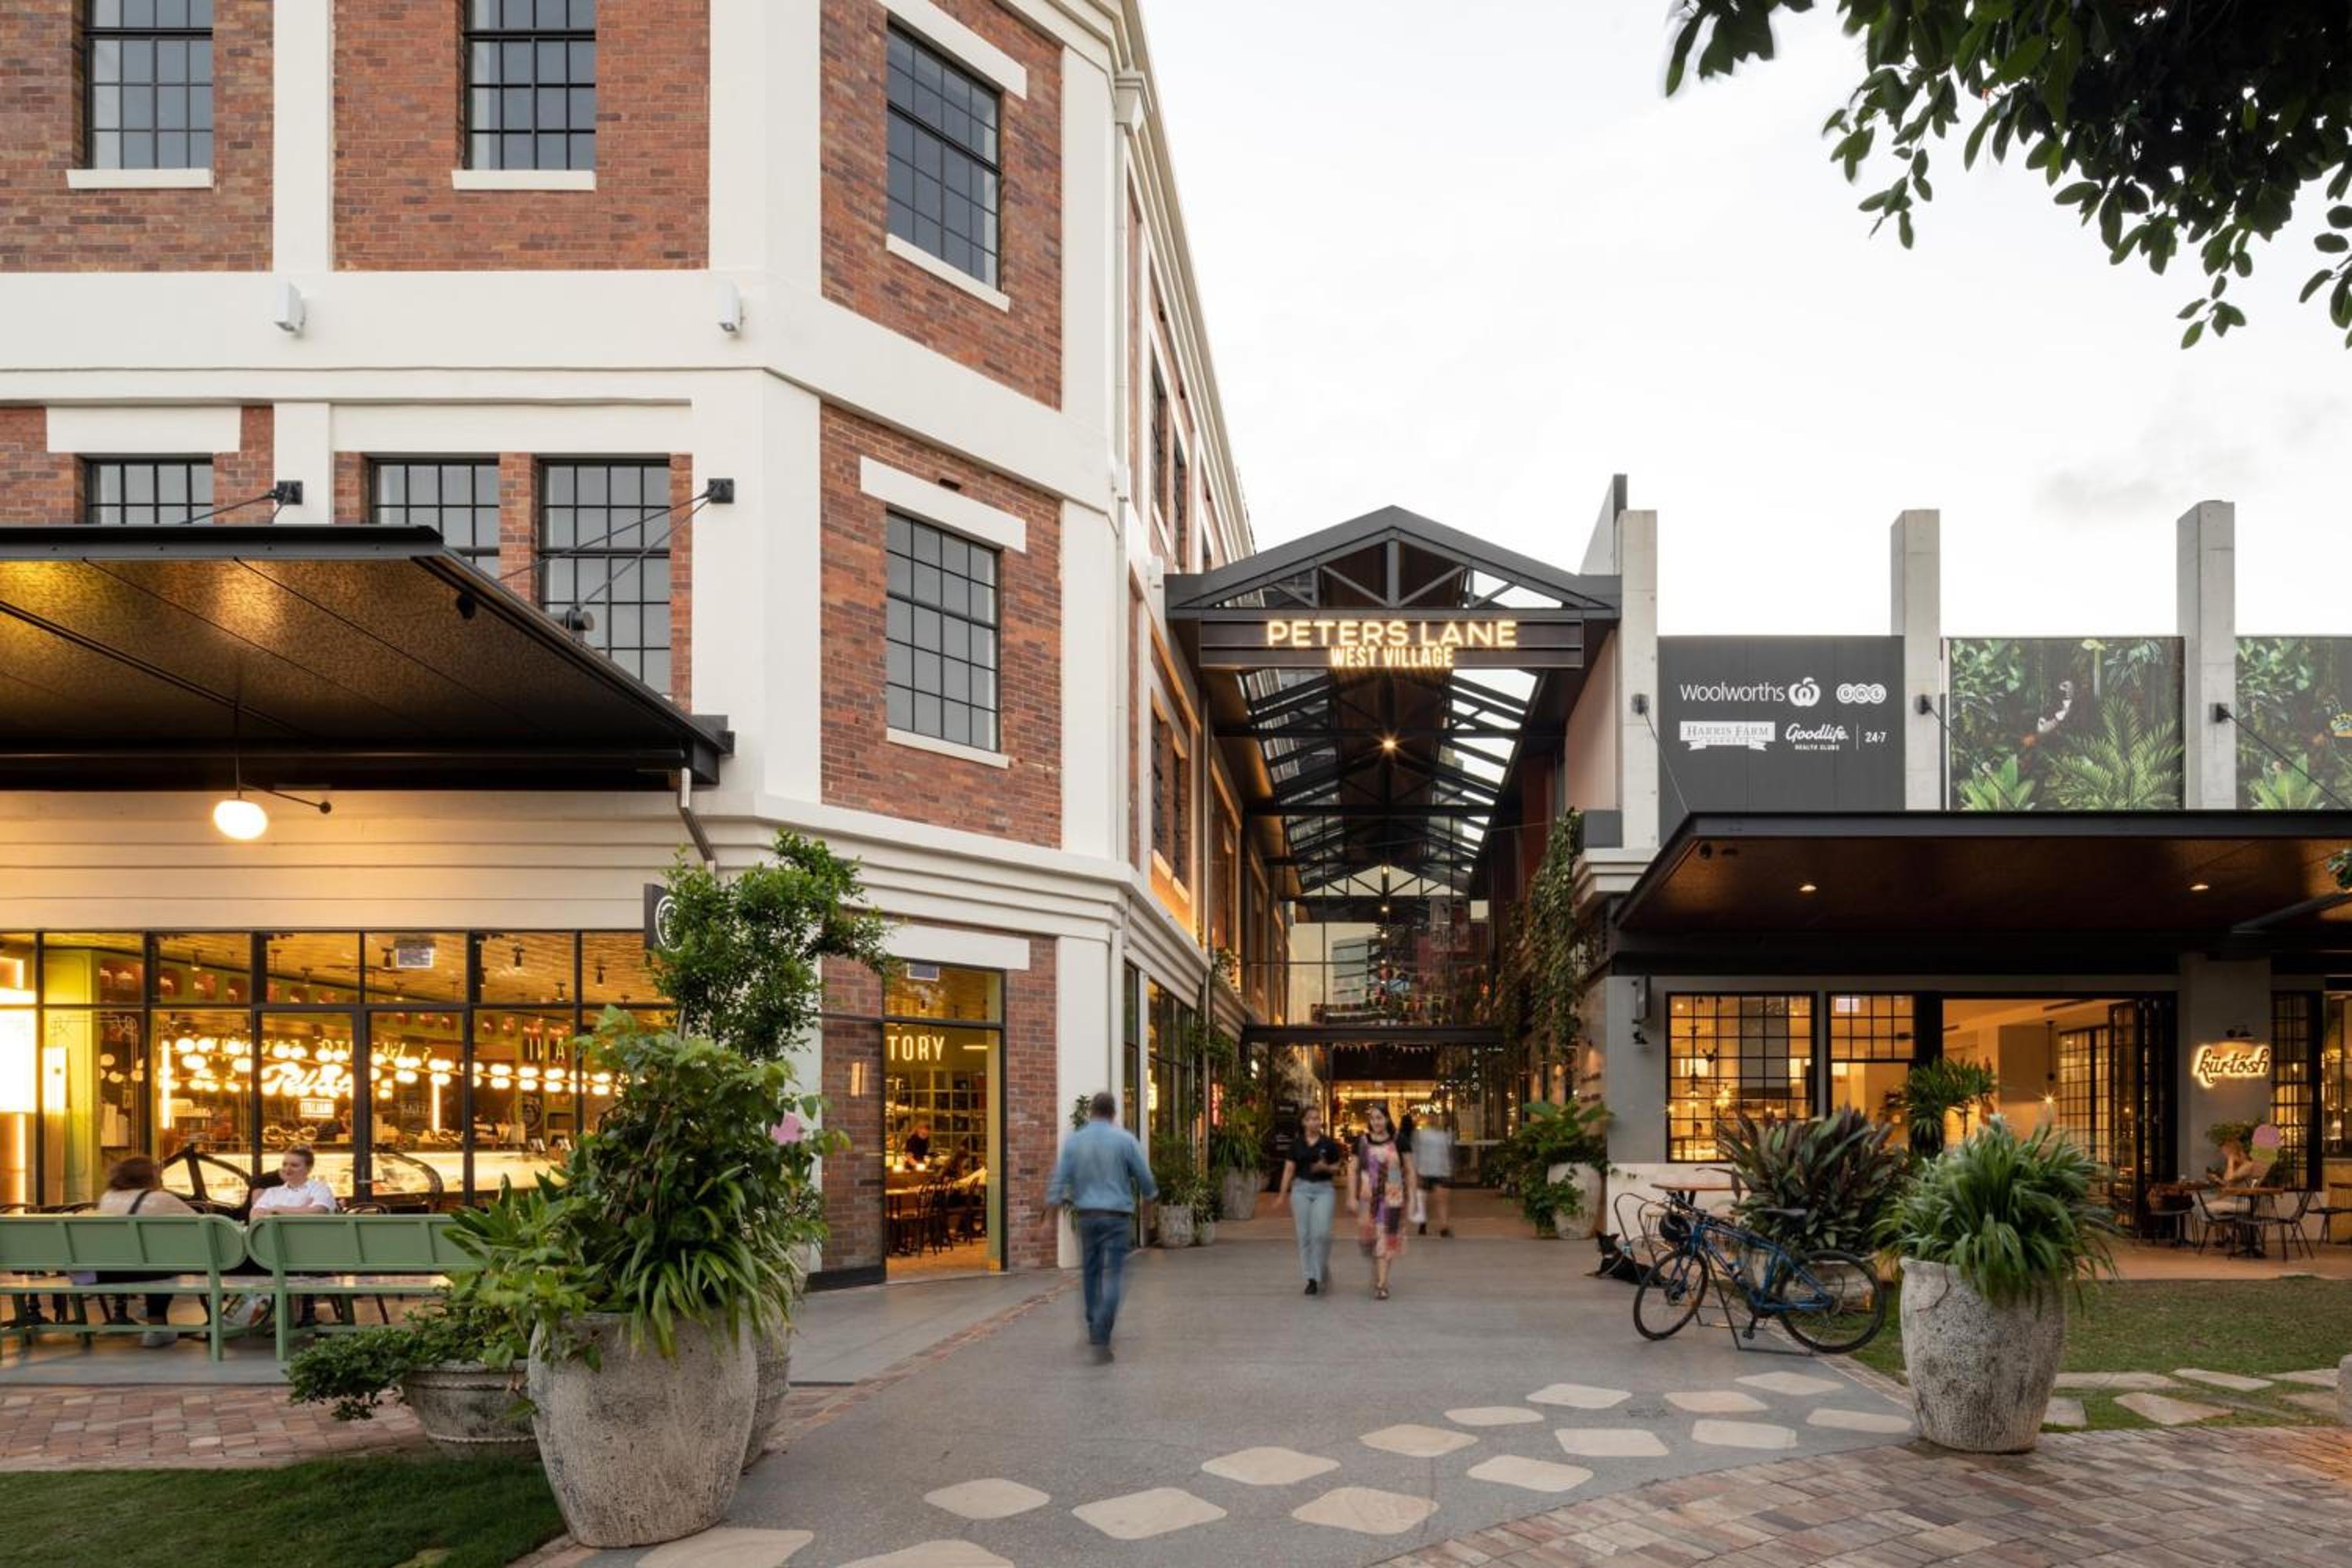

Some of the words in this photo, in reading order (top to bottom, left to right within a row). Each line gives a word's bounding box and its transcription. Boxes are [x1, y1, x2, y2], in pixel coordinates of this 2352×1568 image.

[1267, 619, 1409, 647] PETERS
[1420, 620, 1517, 647] LANE
[1330, 647, 1377, 666] WEST
[1383, 647, 1454, 666] VILLAGE
[1680, 681, 1785, 702] Woolworths
[1785, 723, 1849, 742] Goodlife
